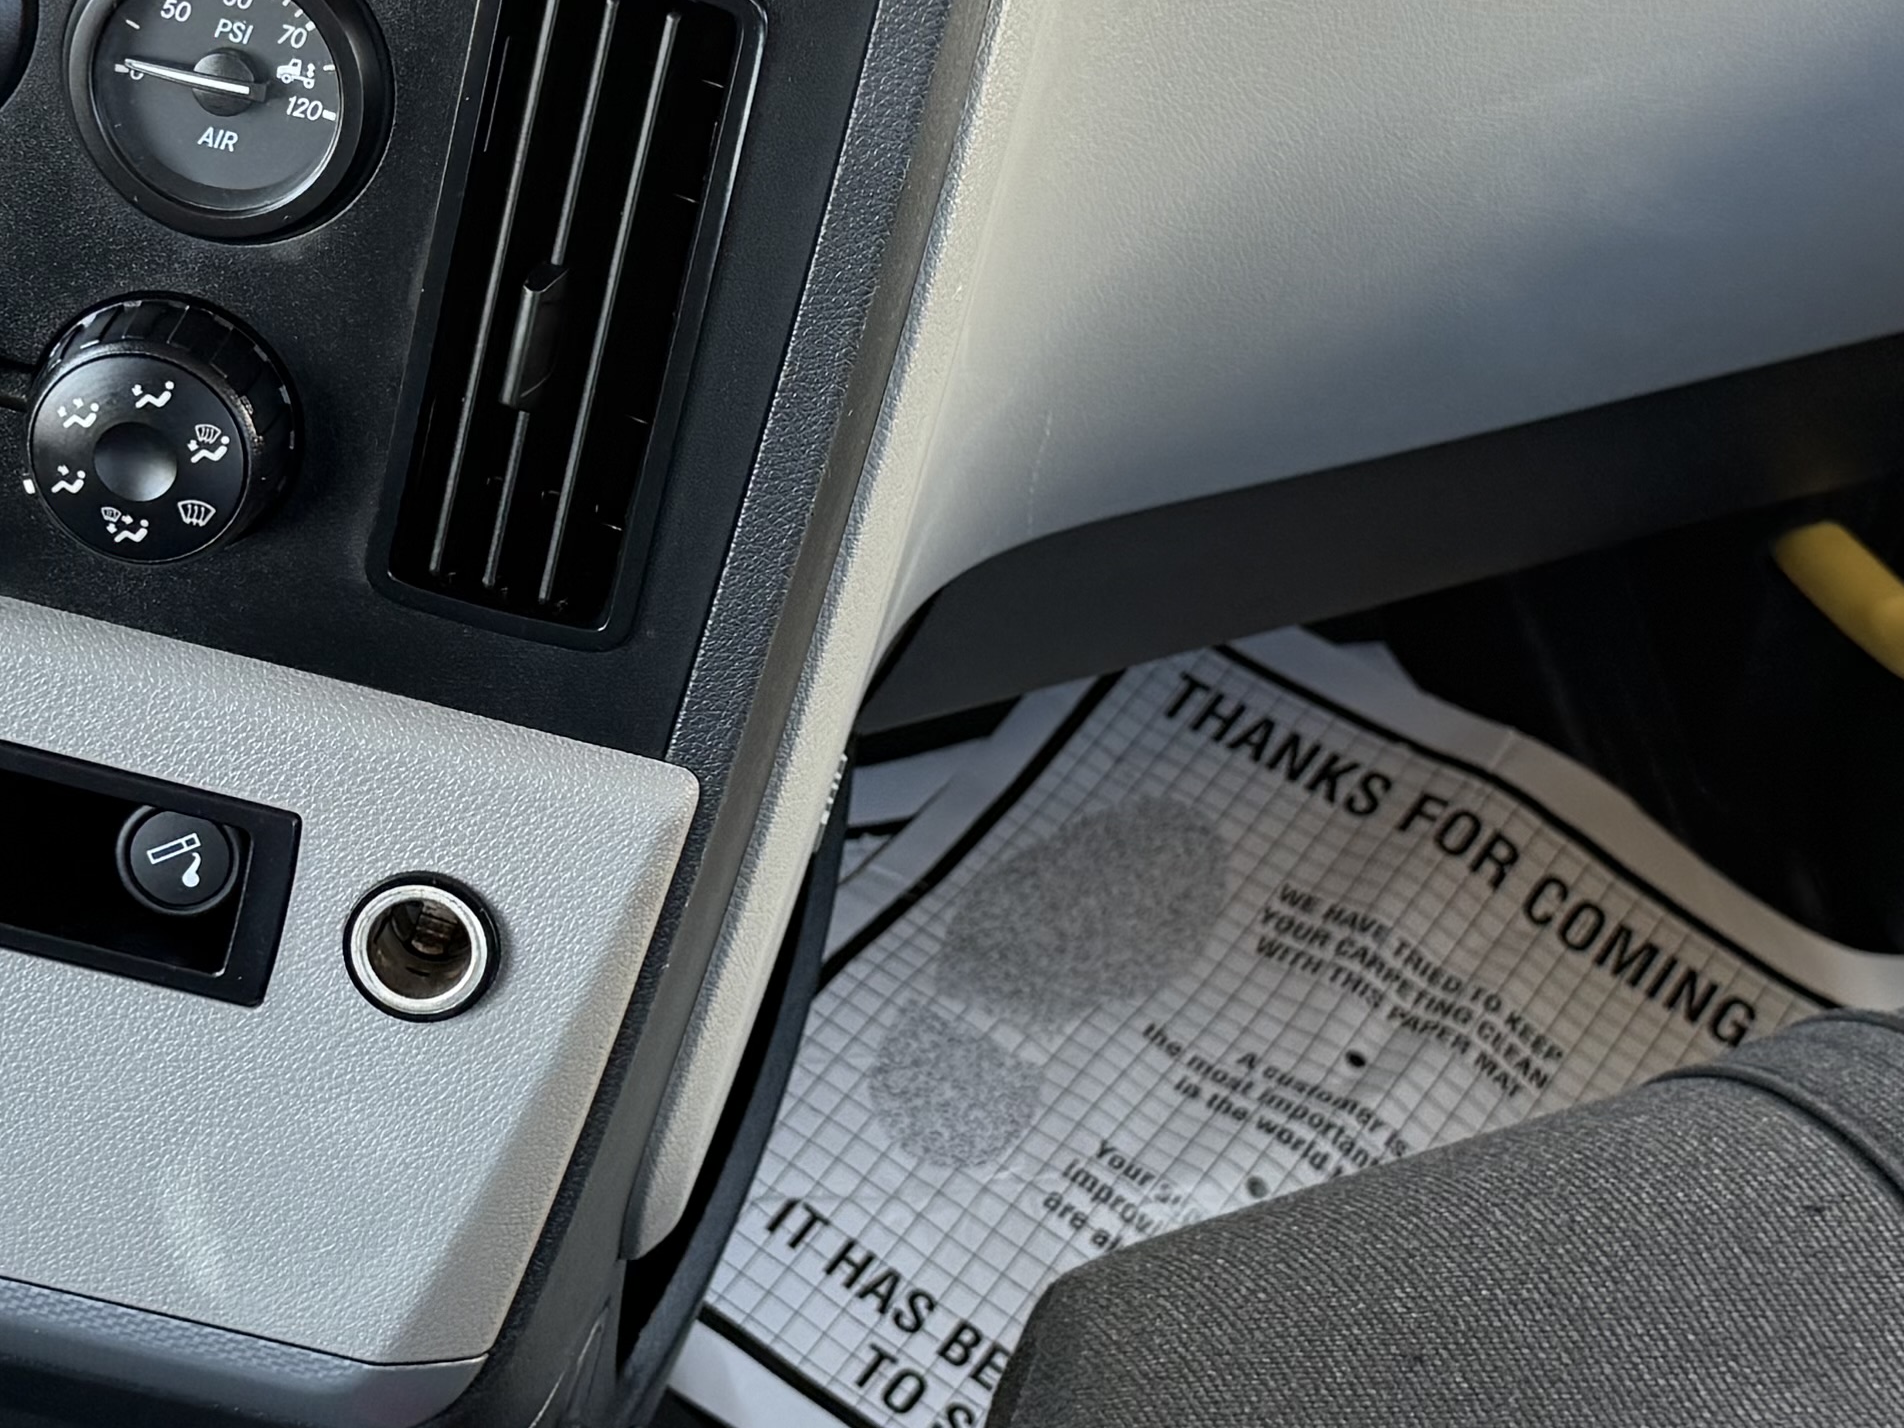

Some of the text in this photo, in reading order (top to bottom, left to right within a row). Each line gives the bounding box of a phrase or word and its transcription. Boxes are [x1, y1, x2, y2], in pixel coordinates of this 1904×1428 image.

[214, 18, 254, 45] PSI
[277, 24, 307, 49] 70
[197, 126, 239, 152] AIR
[286, 96, 323, 122] 120
[1163, 672, 1758, 1049] THANKS FOR COMING
[1262, 906, 1548, 1089] YOUR CARPETING CLEAN
[1279, 883, 1564, 1061] WE HAVE TRIED TO KEEP
[1255, 935, 1523, 1098] WITH THIS PAPER MAT
[1143, 1022, 1183, 1059] the
[1186, 1055, 1254, 1096] most
[1237, 1050, 1256, 1071] A
[1174, 1076, 1200, 1099] in
[1206, 1094, 1250, 1122] the
[1255, 1117, 1330, 1171] world
[1096, 1139, 1155, 1188] Your
[1043, 1191, 1088, 1230] are
[765, 1198, 1012, 1392] IT HAS BE
[856, 1342, 928, 1414] TO
